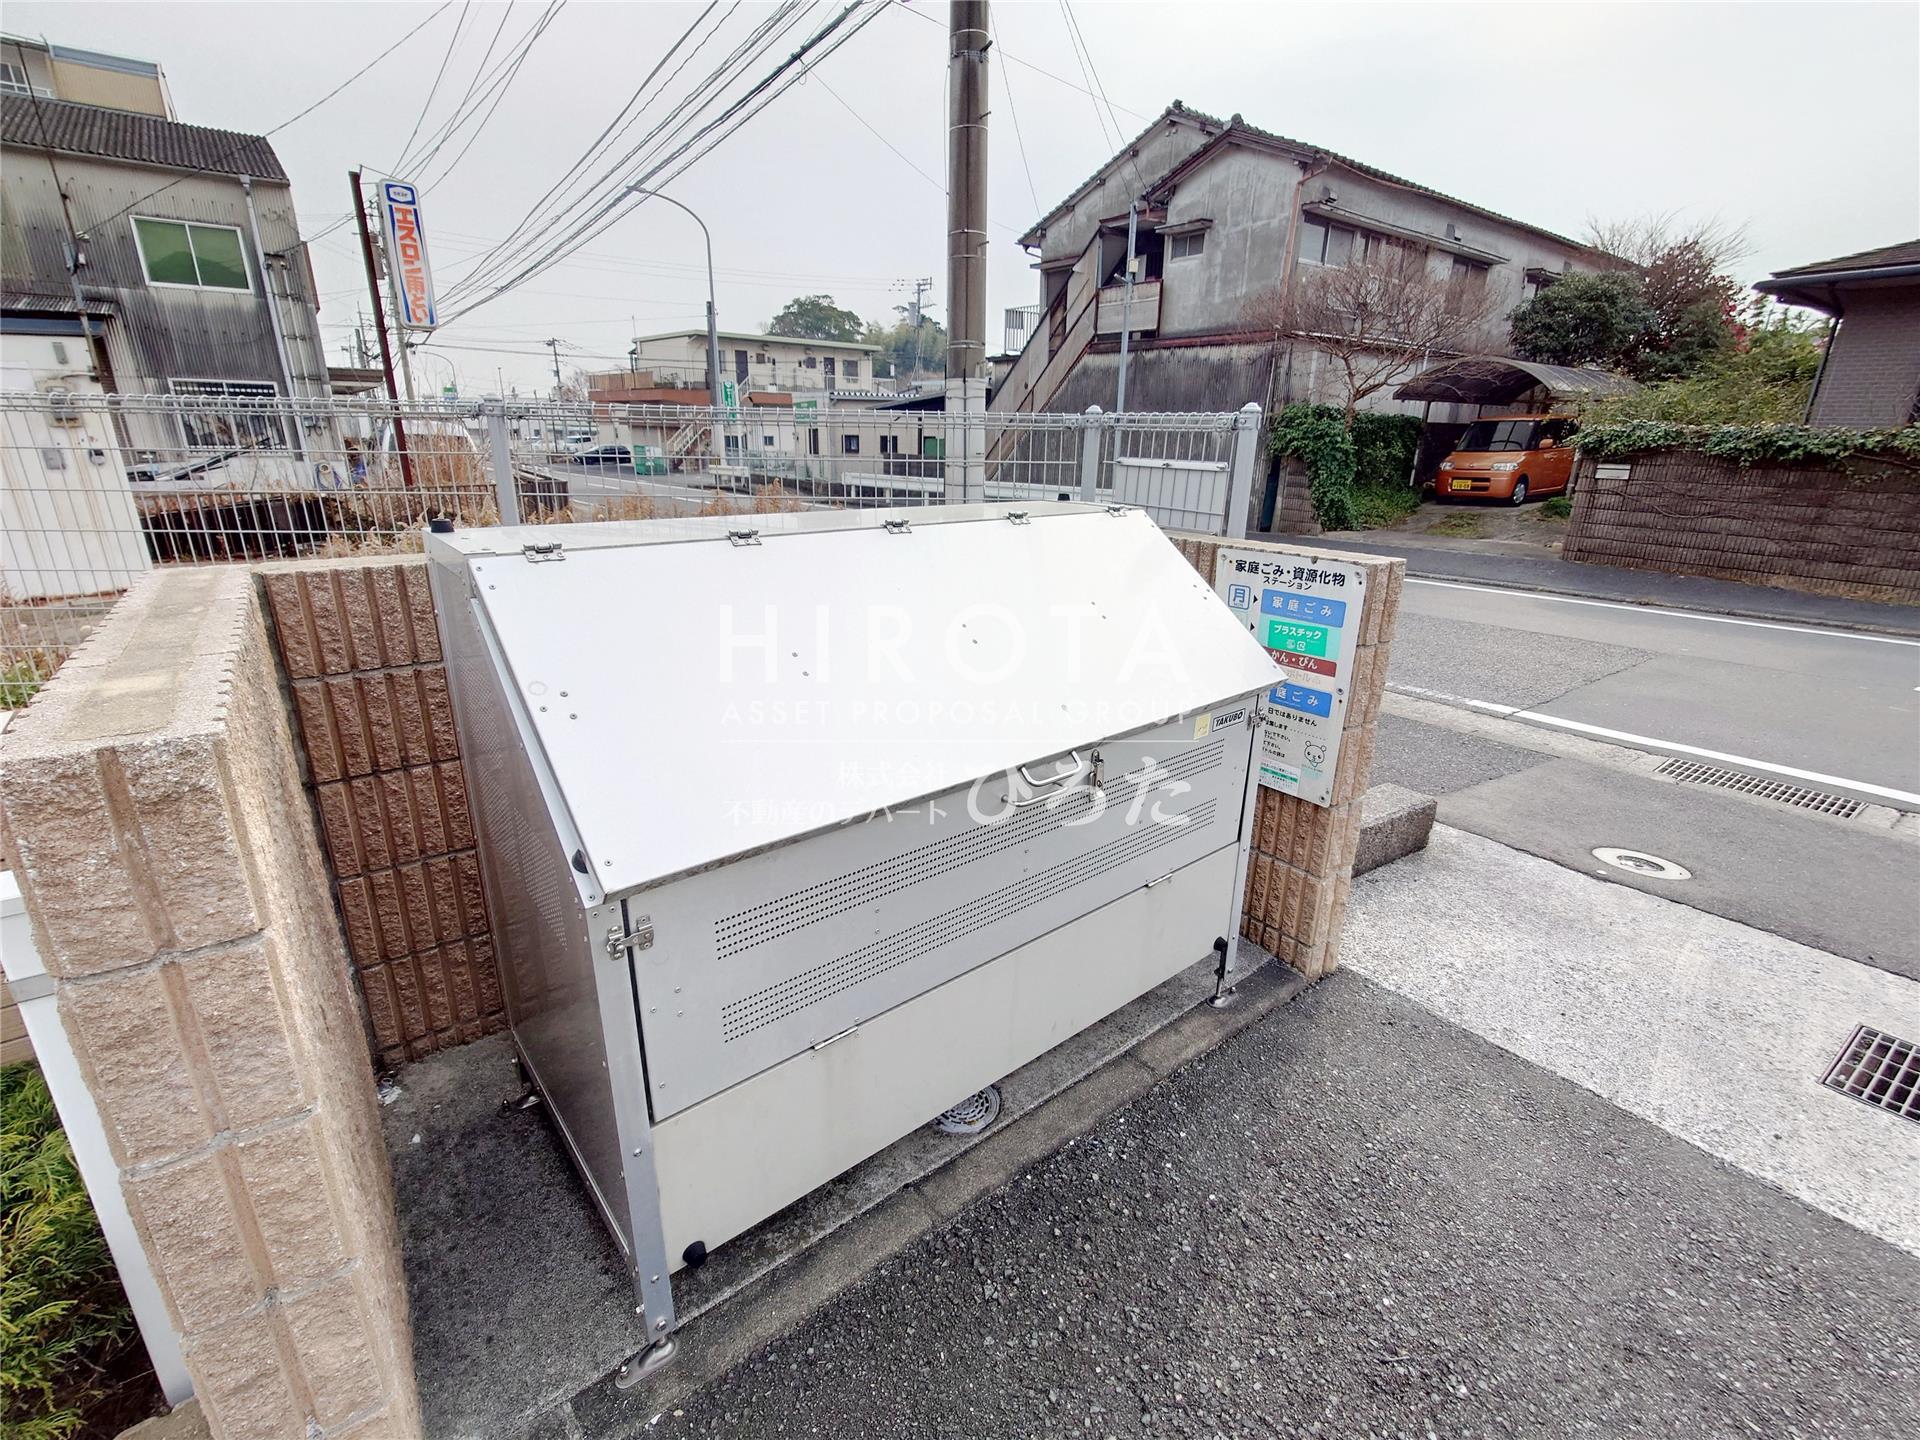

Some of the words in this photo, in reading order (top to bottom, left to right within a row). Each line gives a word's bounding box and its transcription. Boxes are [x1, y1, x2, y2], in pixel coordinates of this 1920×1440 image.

[1235, 558, 1346, 587] 家庭ごみ・資源化物
[1263, 576, 1313, 591] ステーション
[1233, 588, 1246, 603] 月
[1272, 596, 1332, 617] 家庭ごみ
[1274, 624, 1322, 639] プラスチック
[1215, 711, 1244, 727] TAKUBO
